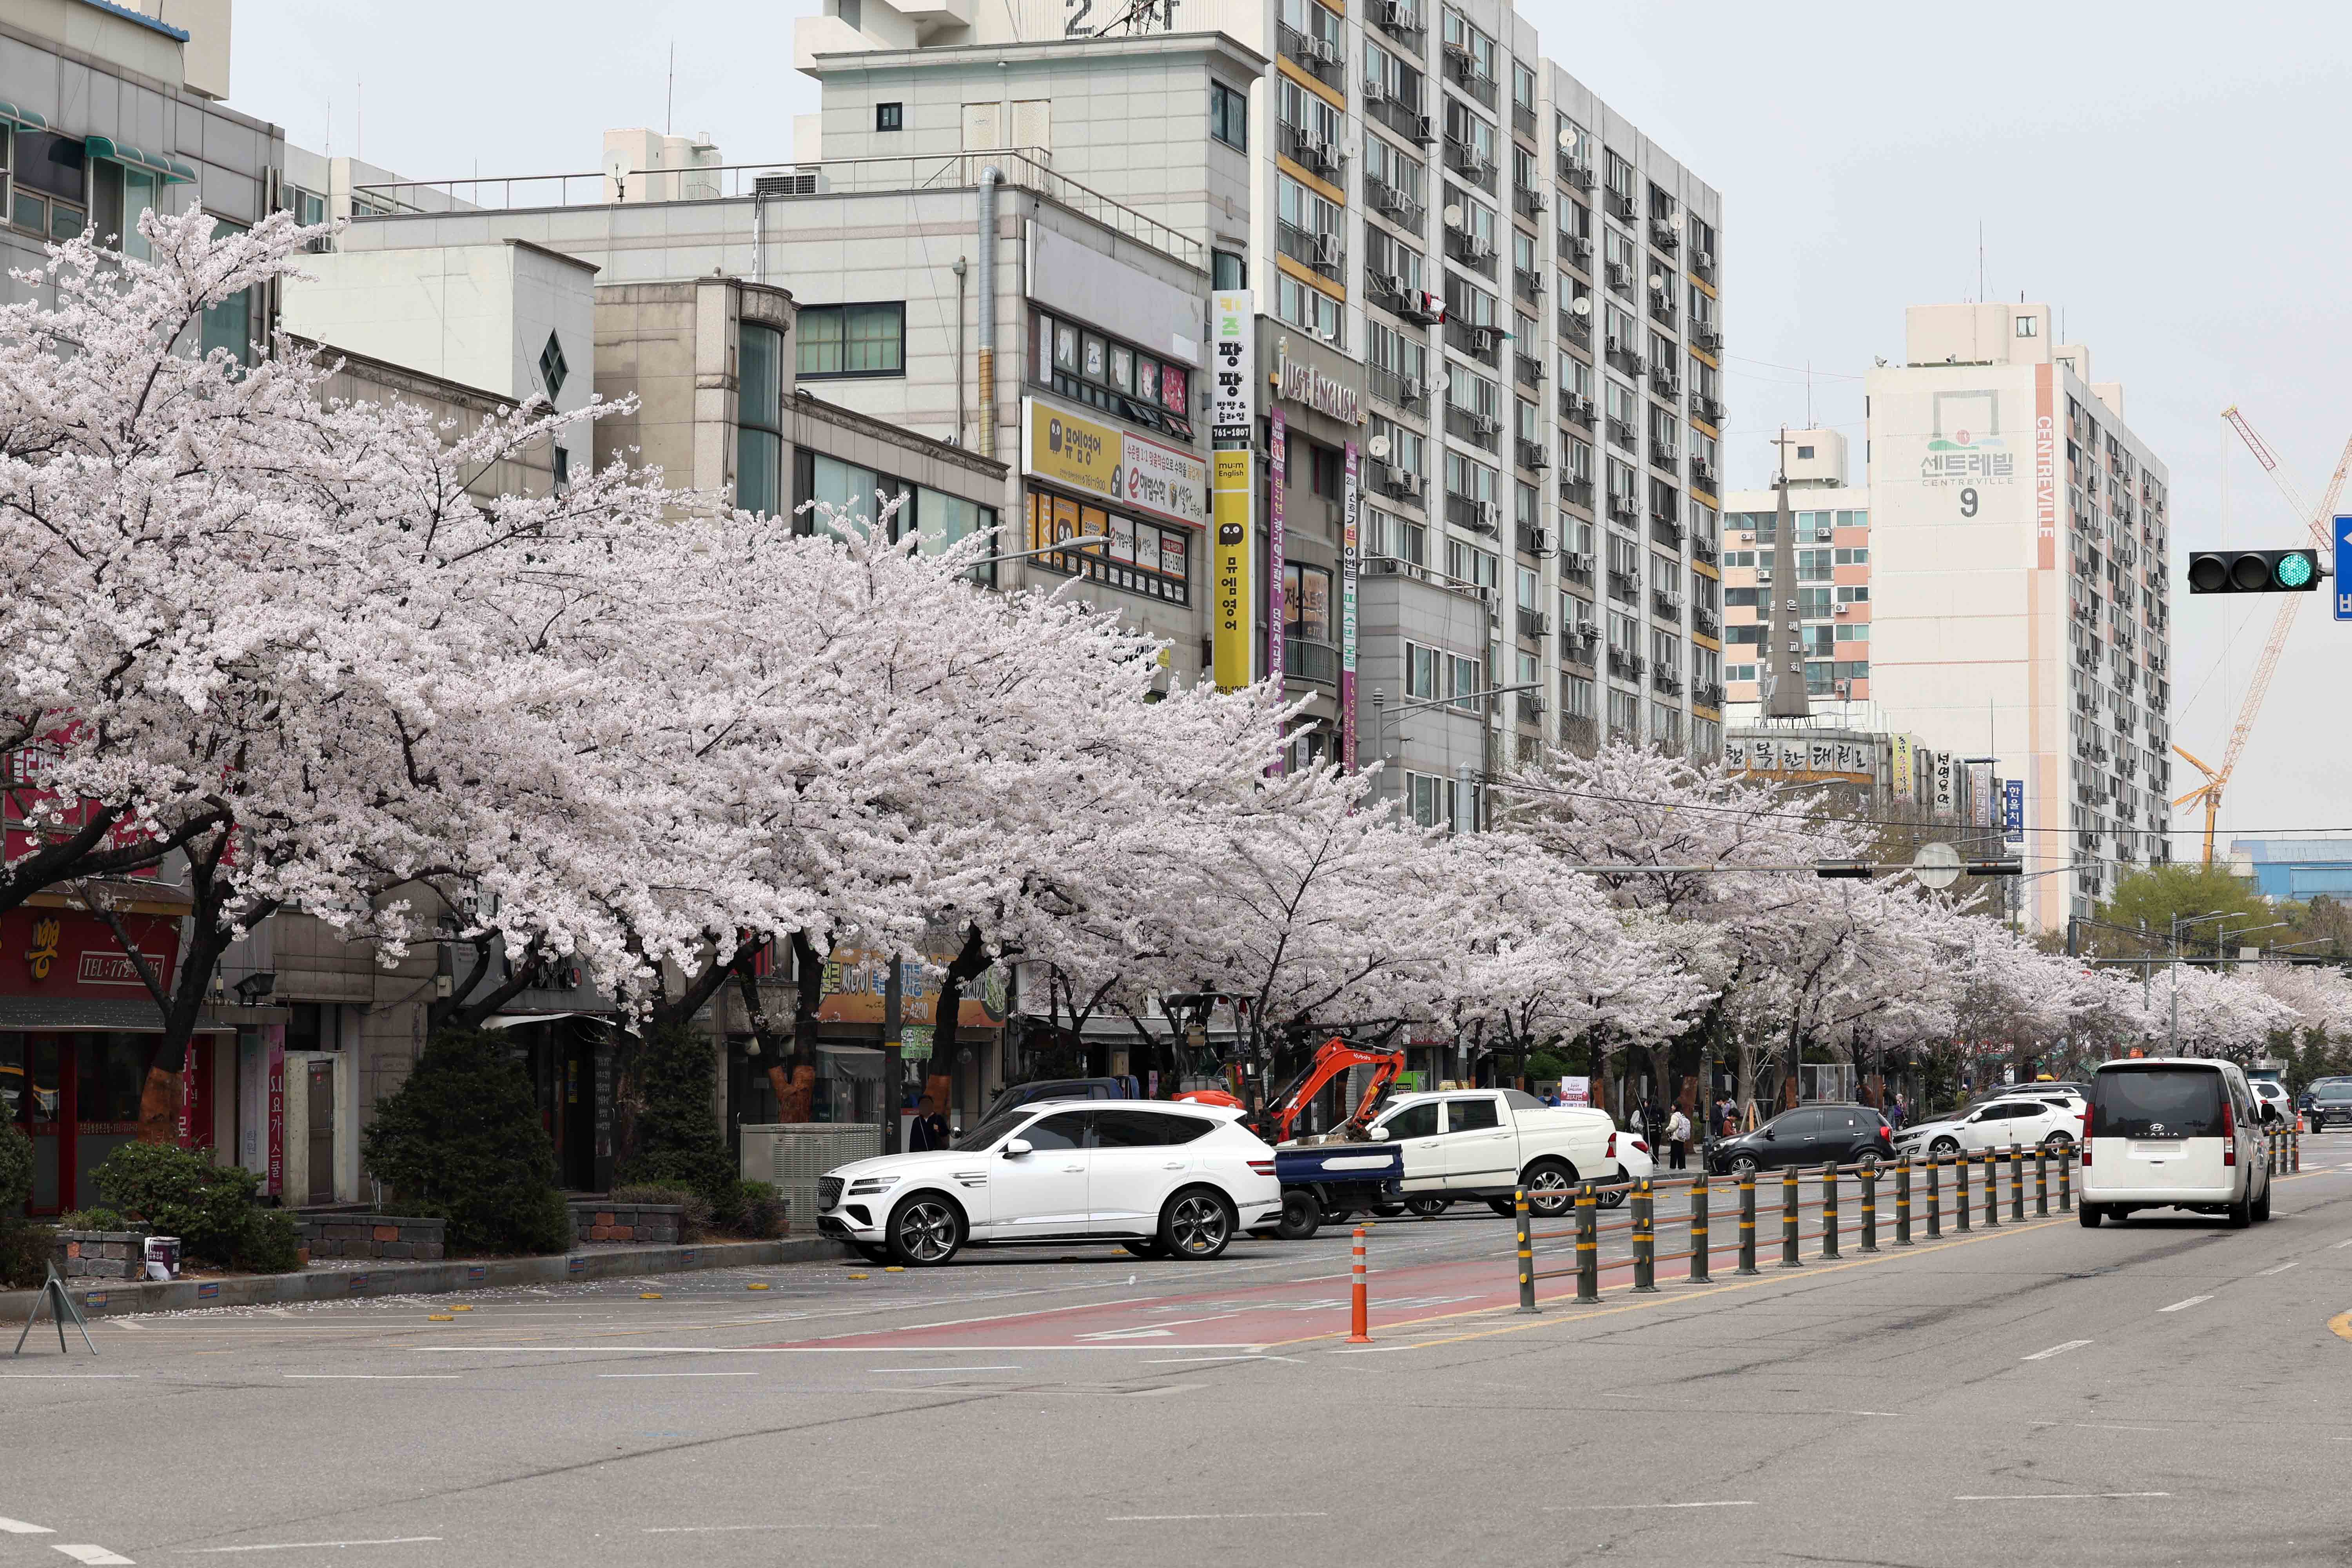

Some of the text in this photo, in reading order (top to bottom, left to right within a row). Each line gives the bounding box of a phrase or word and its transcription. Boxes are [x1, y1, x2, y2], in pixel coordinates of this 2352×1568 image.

[1216, 401, 1236, 410] 방방
[1309, 367, 1358, 426] ENGLISH
[1218, 412, 1245, 423] 슬라임
[1213, 428, 1249, 437] 761-1807
[1064, 427, 1101, 466] 뮤엠영어
[1127, 443, 1139, 461] 수준별
[1175, 460, 1187, 478] 수학을
[1920, 453, 2014, 477] 센트레빌
[1140, 472, 1166, 505] 해법수학
[1922, 477, 2014, 487] CENTREVILLE
[2037, 416, 2054, 538] CENTREVILLE
[1960, 487, 1979, 518] 9
[1116, 530, 1133, 551] 해법수학
[1162, 551, 1183, 572] 761-1900
[1221, 557, 1238, 631] 뮤엠영어
